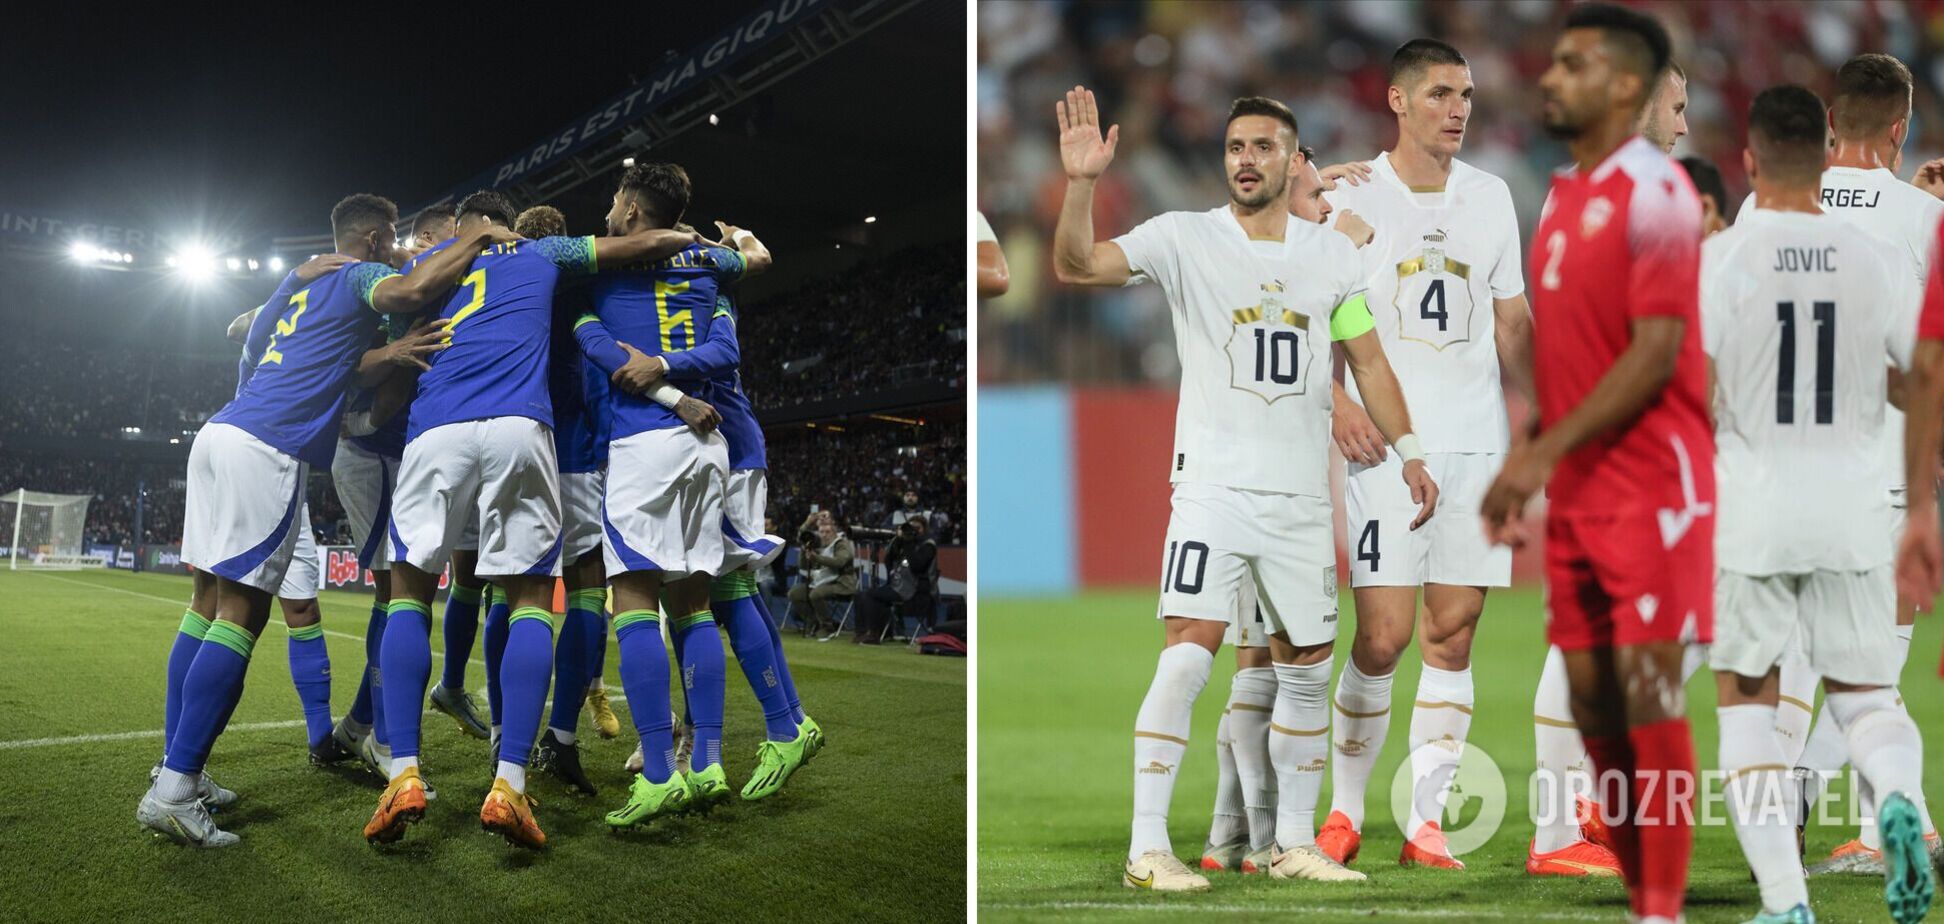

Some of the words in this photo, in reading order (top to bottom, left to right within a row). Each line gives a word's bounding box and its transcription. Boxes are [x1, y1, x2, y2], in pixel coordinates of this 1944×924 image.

[493, 127, 578, 189] PARIS
[579, 88, 646, 141] EST
[646, 0, 826, 103] MAGIQU
[1541, 230, 1567, 291] 2
[259, 288, 311, 365] 2
[655, 280, 695, 352] 6
[1420, 279, 1449, 332] 4
[1254, 327, 1299, 386] 10
[1777, 301, 1835, 425] 11
[1164, 540, 1209, 595] 10
[1357, 519, 1381, 573] 4
[1323, 613, 1338, 623] PUM
